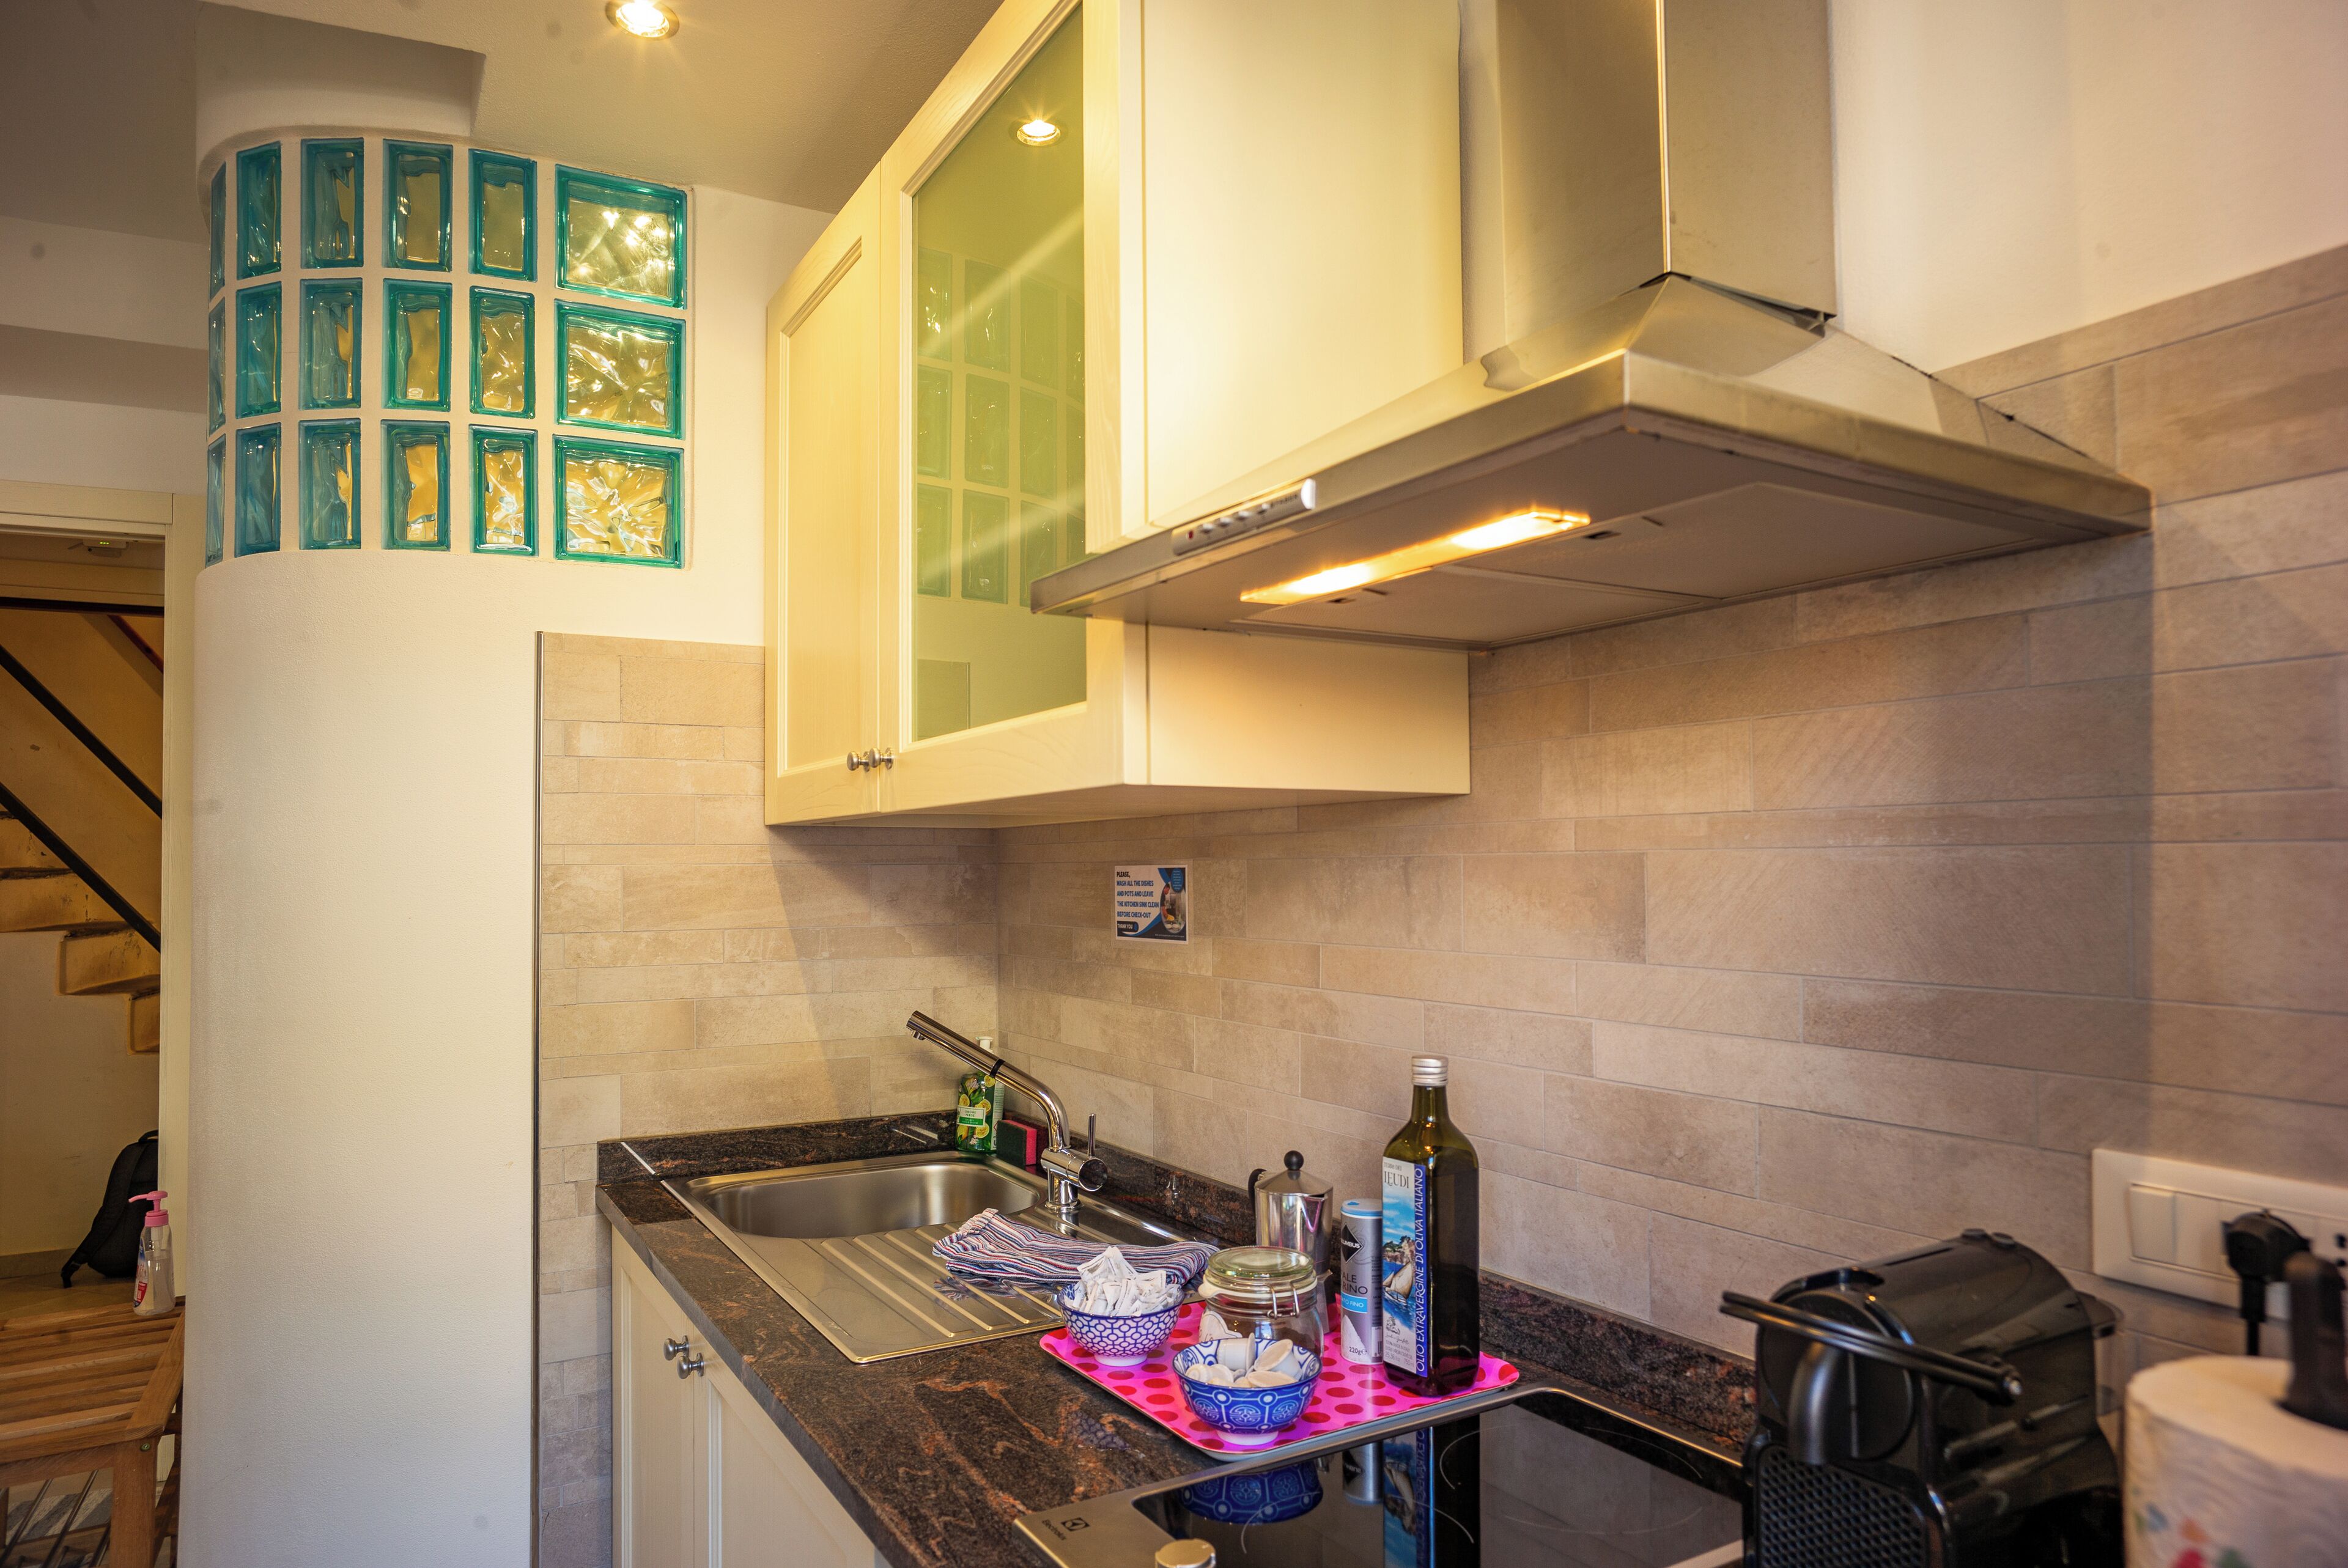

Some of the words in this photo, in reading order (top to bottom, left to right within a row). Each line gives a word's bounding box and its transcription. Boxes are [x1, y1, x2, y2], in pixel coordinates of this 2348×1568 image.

[1415, 1220, 1423, 1250] OLIVA
[1341, 1239, 1360, 1248] LUMBUS
[1415, 1253, 1423, 1264] DI
[1343, 1272, 1357, 1283] ALE
[1343, 1281, 1368, 1295] RINO
[1416, 1266, 1425, 1342] EXTRAVERGINE
[1416, 1344, 1425, 1372] OLIO
